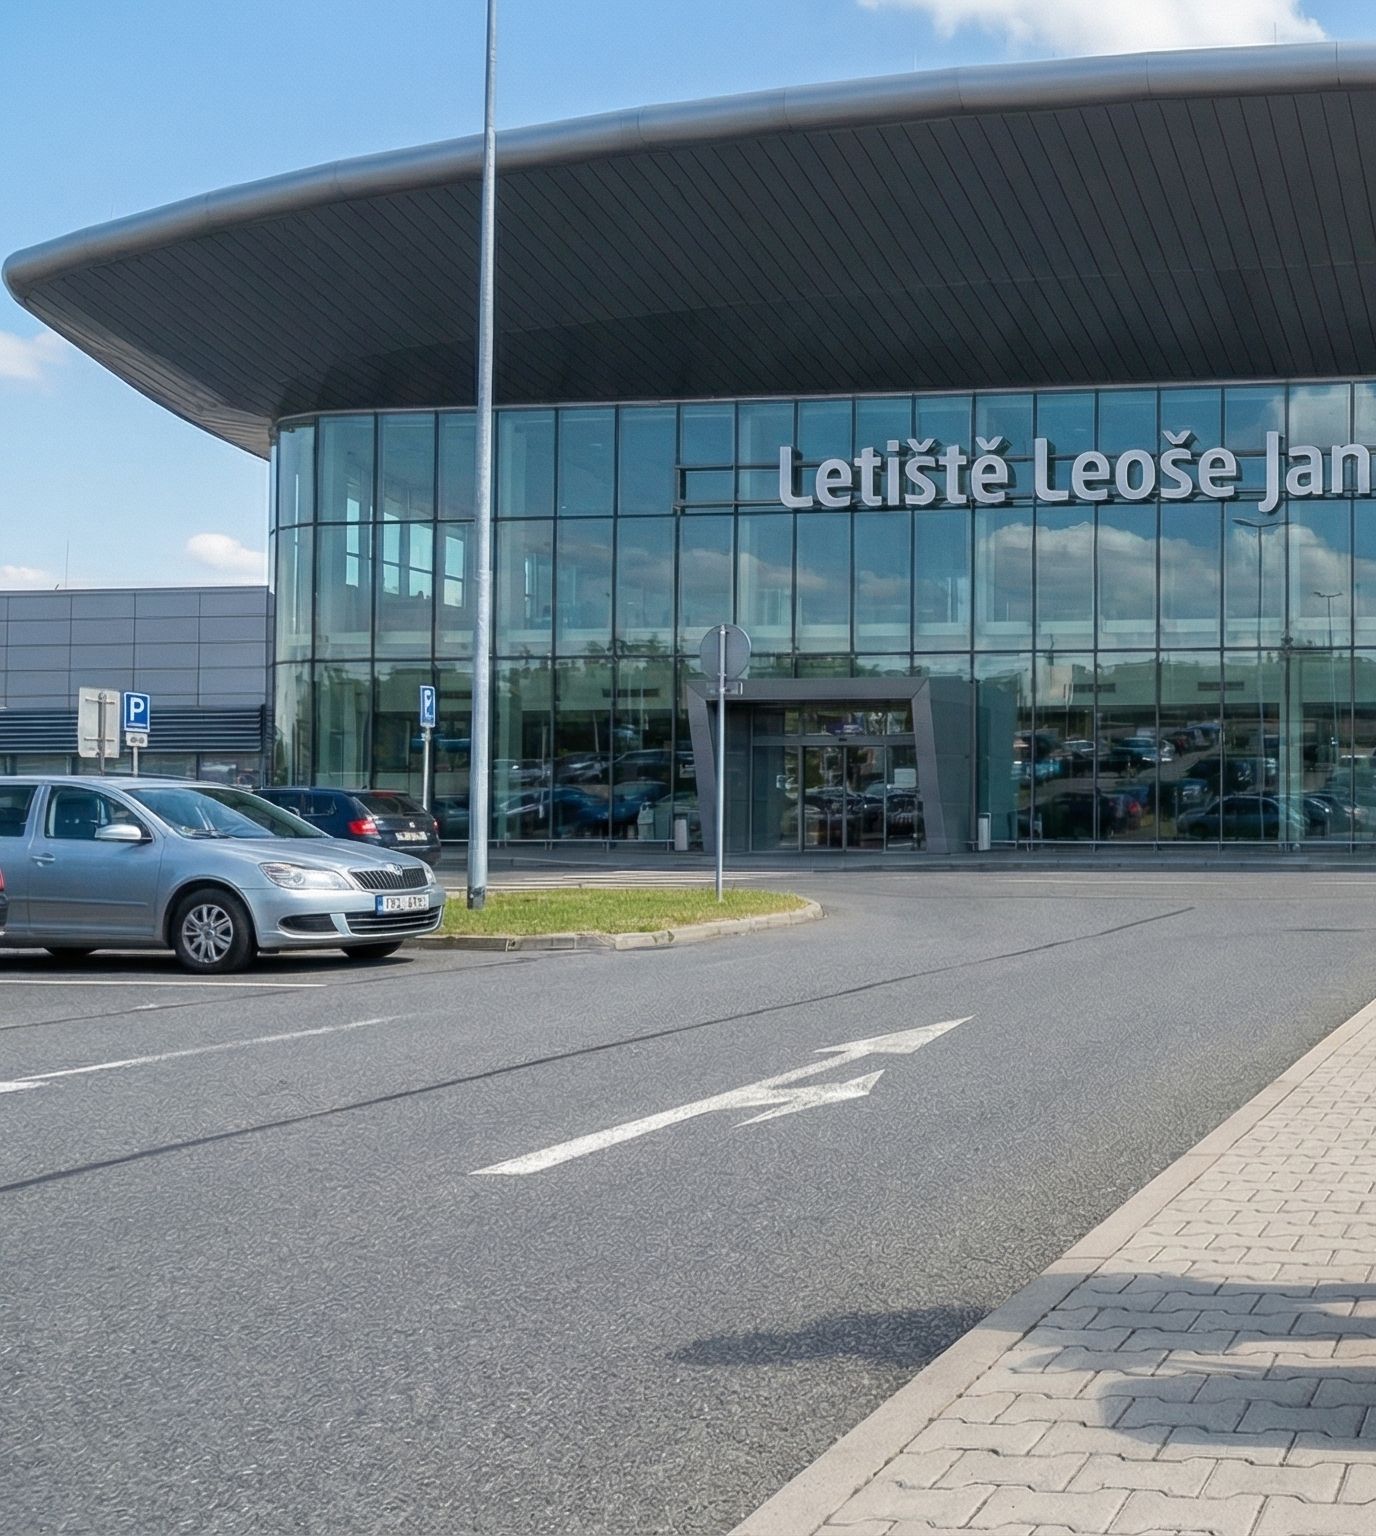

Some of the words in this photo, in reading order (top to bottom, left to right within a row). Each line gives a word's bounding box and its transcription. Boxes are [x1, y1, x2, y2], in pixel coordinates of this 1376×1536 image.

[778, 436, 1009, 508] Letiště
[1034, 430, 1237, 501] Leoše
[130, 697, 145, 721] P
